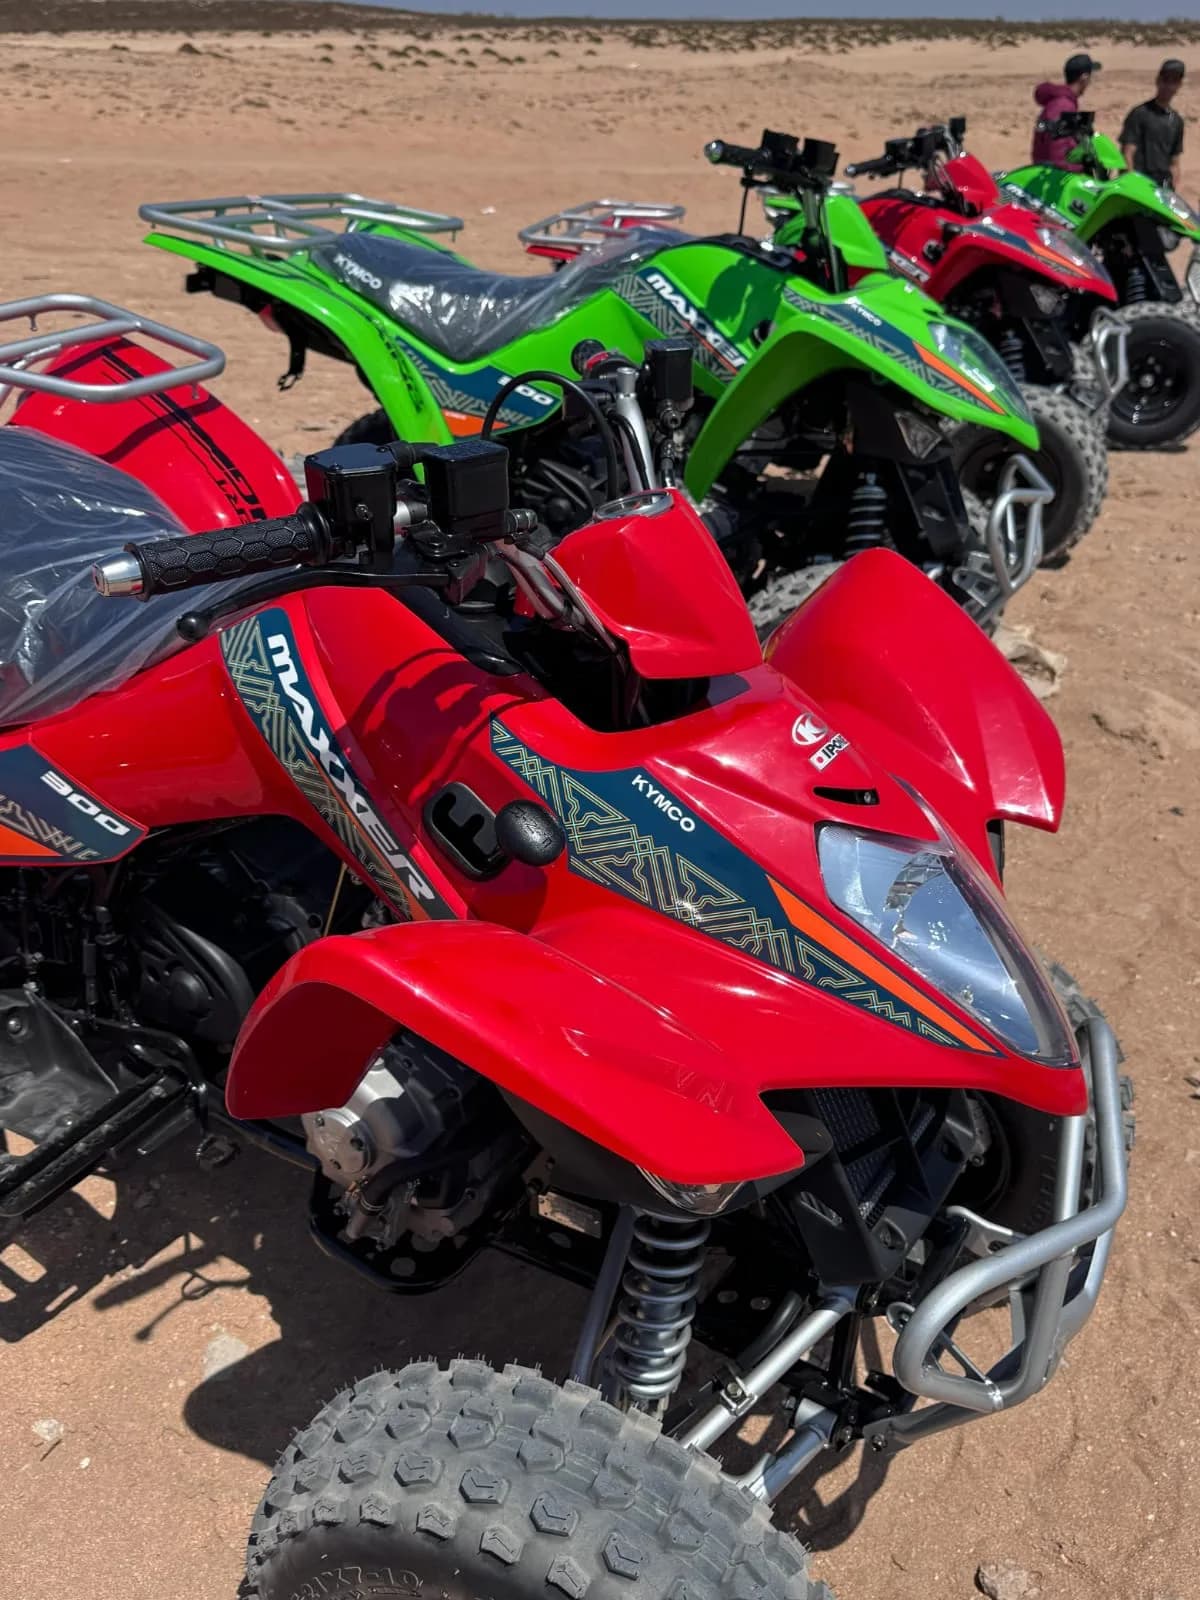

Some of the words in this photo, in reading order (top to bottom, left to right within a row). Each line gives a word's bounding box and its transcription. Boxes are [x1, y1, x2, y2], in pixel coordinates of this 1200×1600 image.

[333, 253, 382, 289] KYMCO
[267, 633, 435, 900] MAXXER
[40, 770, 131, 836] 300
[631, 774, 696, 832] KYMCO
